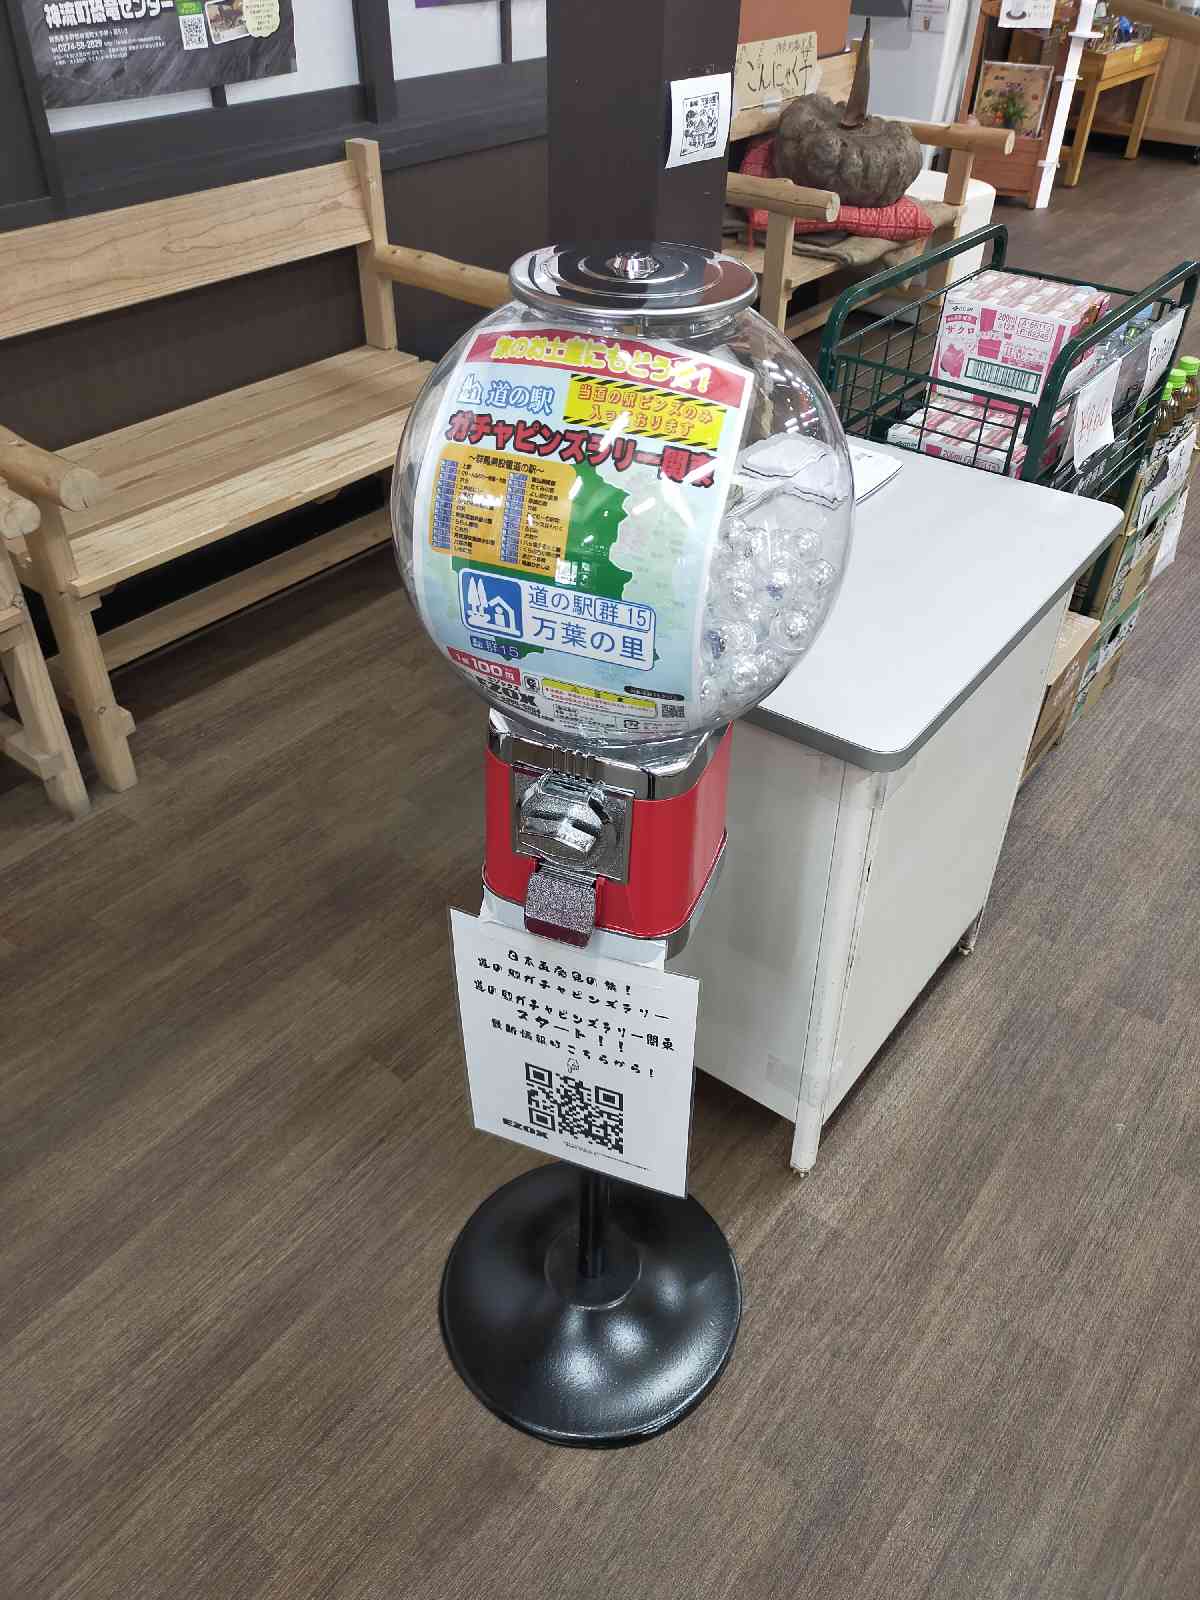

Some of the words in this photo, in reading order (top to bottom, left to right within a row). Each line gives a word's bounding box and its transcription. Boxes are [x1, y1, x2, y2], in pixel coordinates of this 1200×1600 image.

[485, 379, 556, 416] 道の駅
[528, 585, 593, 617] 道の駅
[532, 616, 646, 661] 万葉の里
[478, 957, 671, 1019] 道の駅ガチャピンズラリー
[473, 979, 675, 1051] 道の駅ガチャピンズラリー関東
